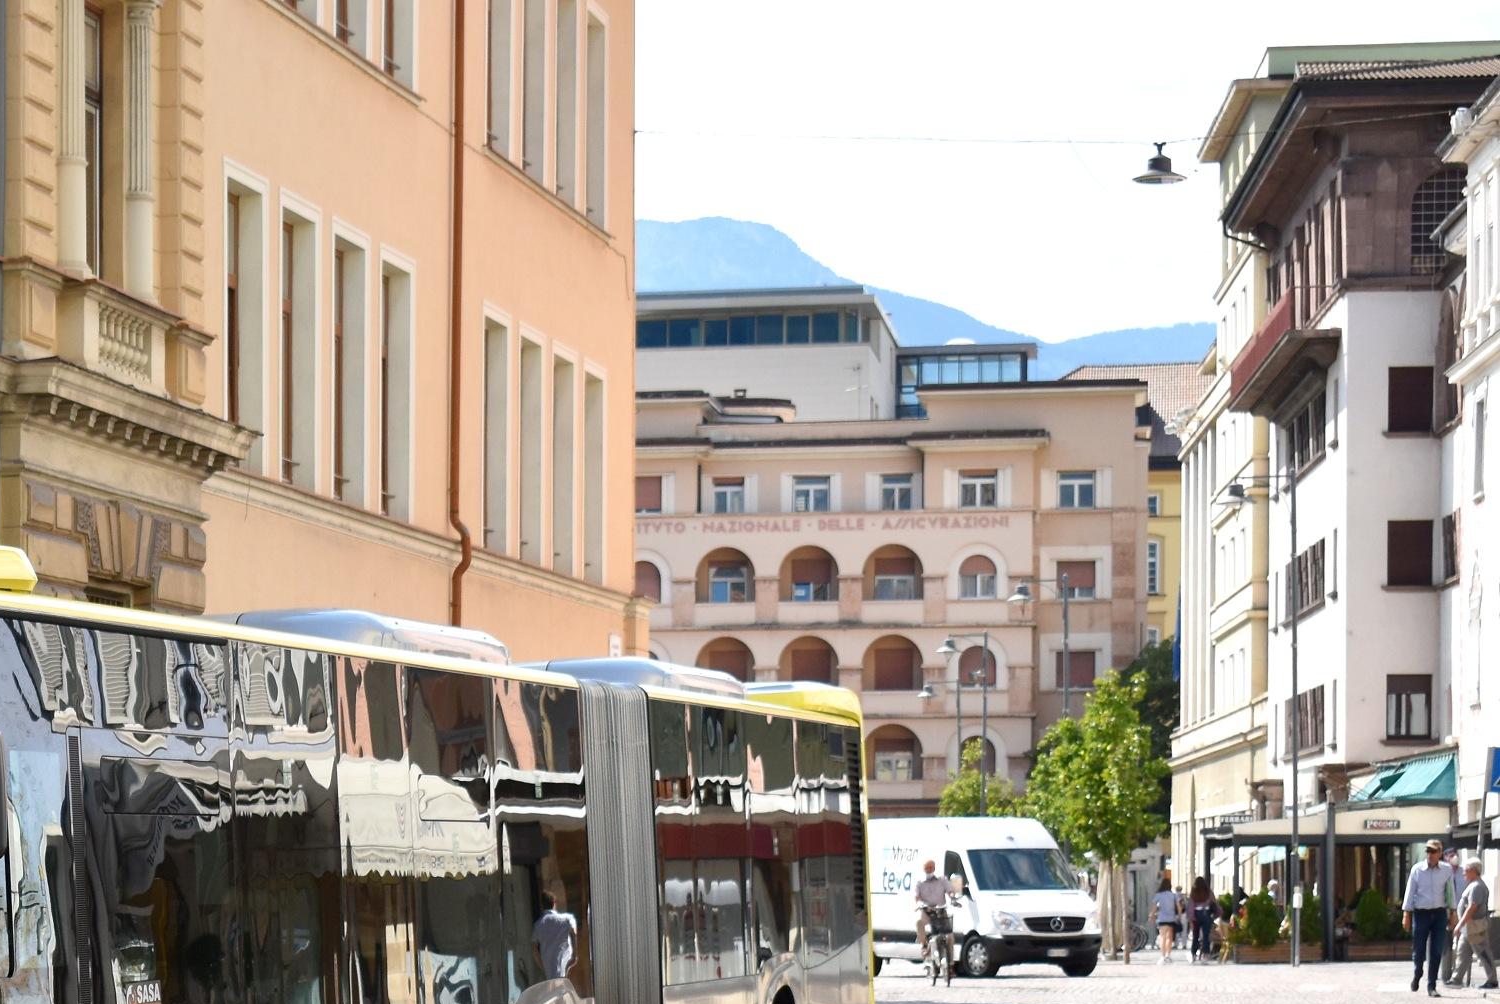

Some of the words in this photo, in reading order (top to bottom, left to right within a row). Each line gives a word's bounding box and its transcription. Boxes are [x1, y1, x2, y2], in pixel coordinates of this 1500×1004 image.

[701, 519, 801, 534] NAZIONALE
[818, 517, 865, 532] DELLE
[882, 867, 912, 891] teva
[137, 983, 161, 1003] SASA
